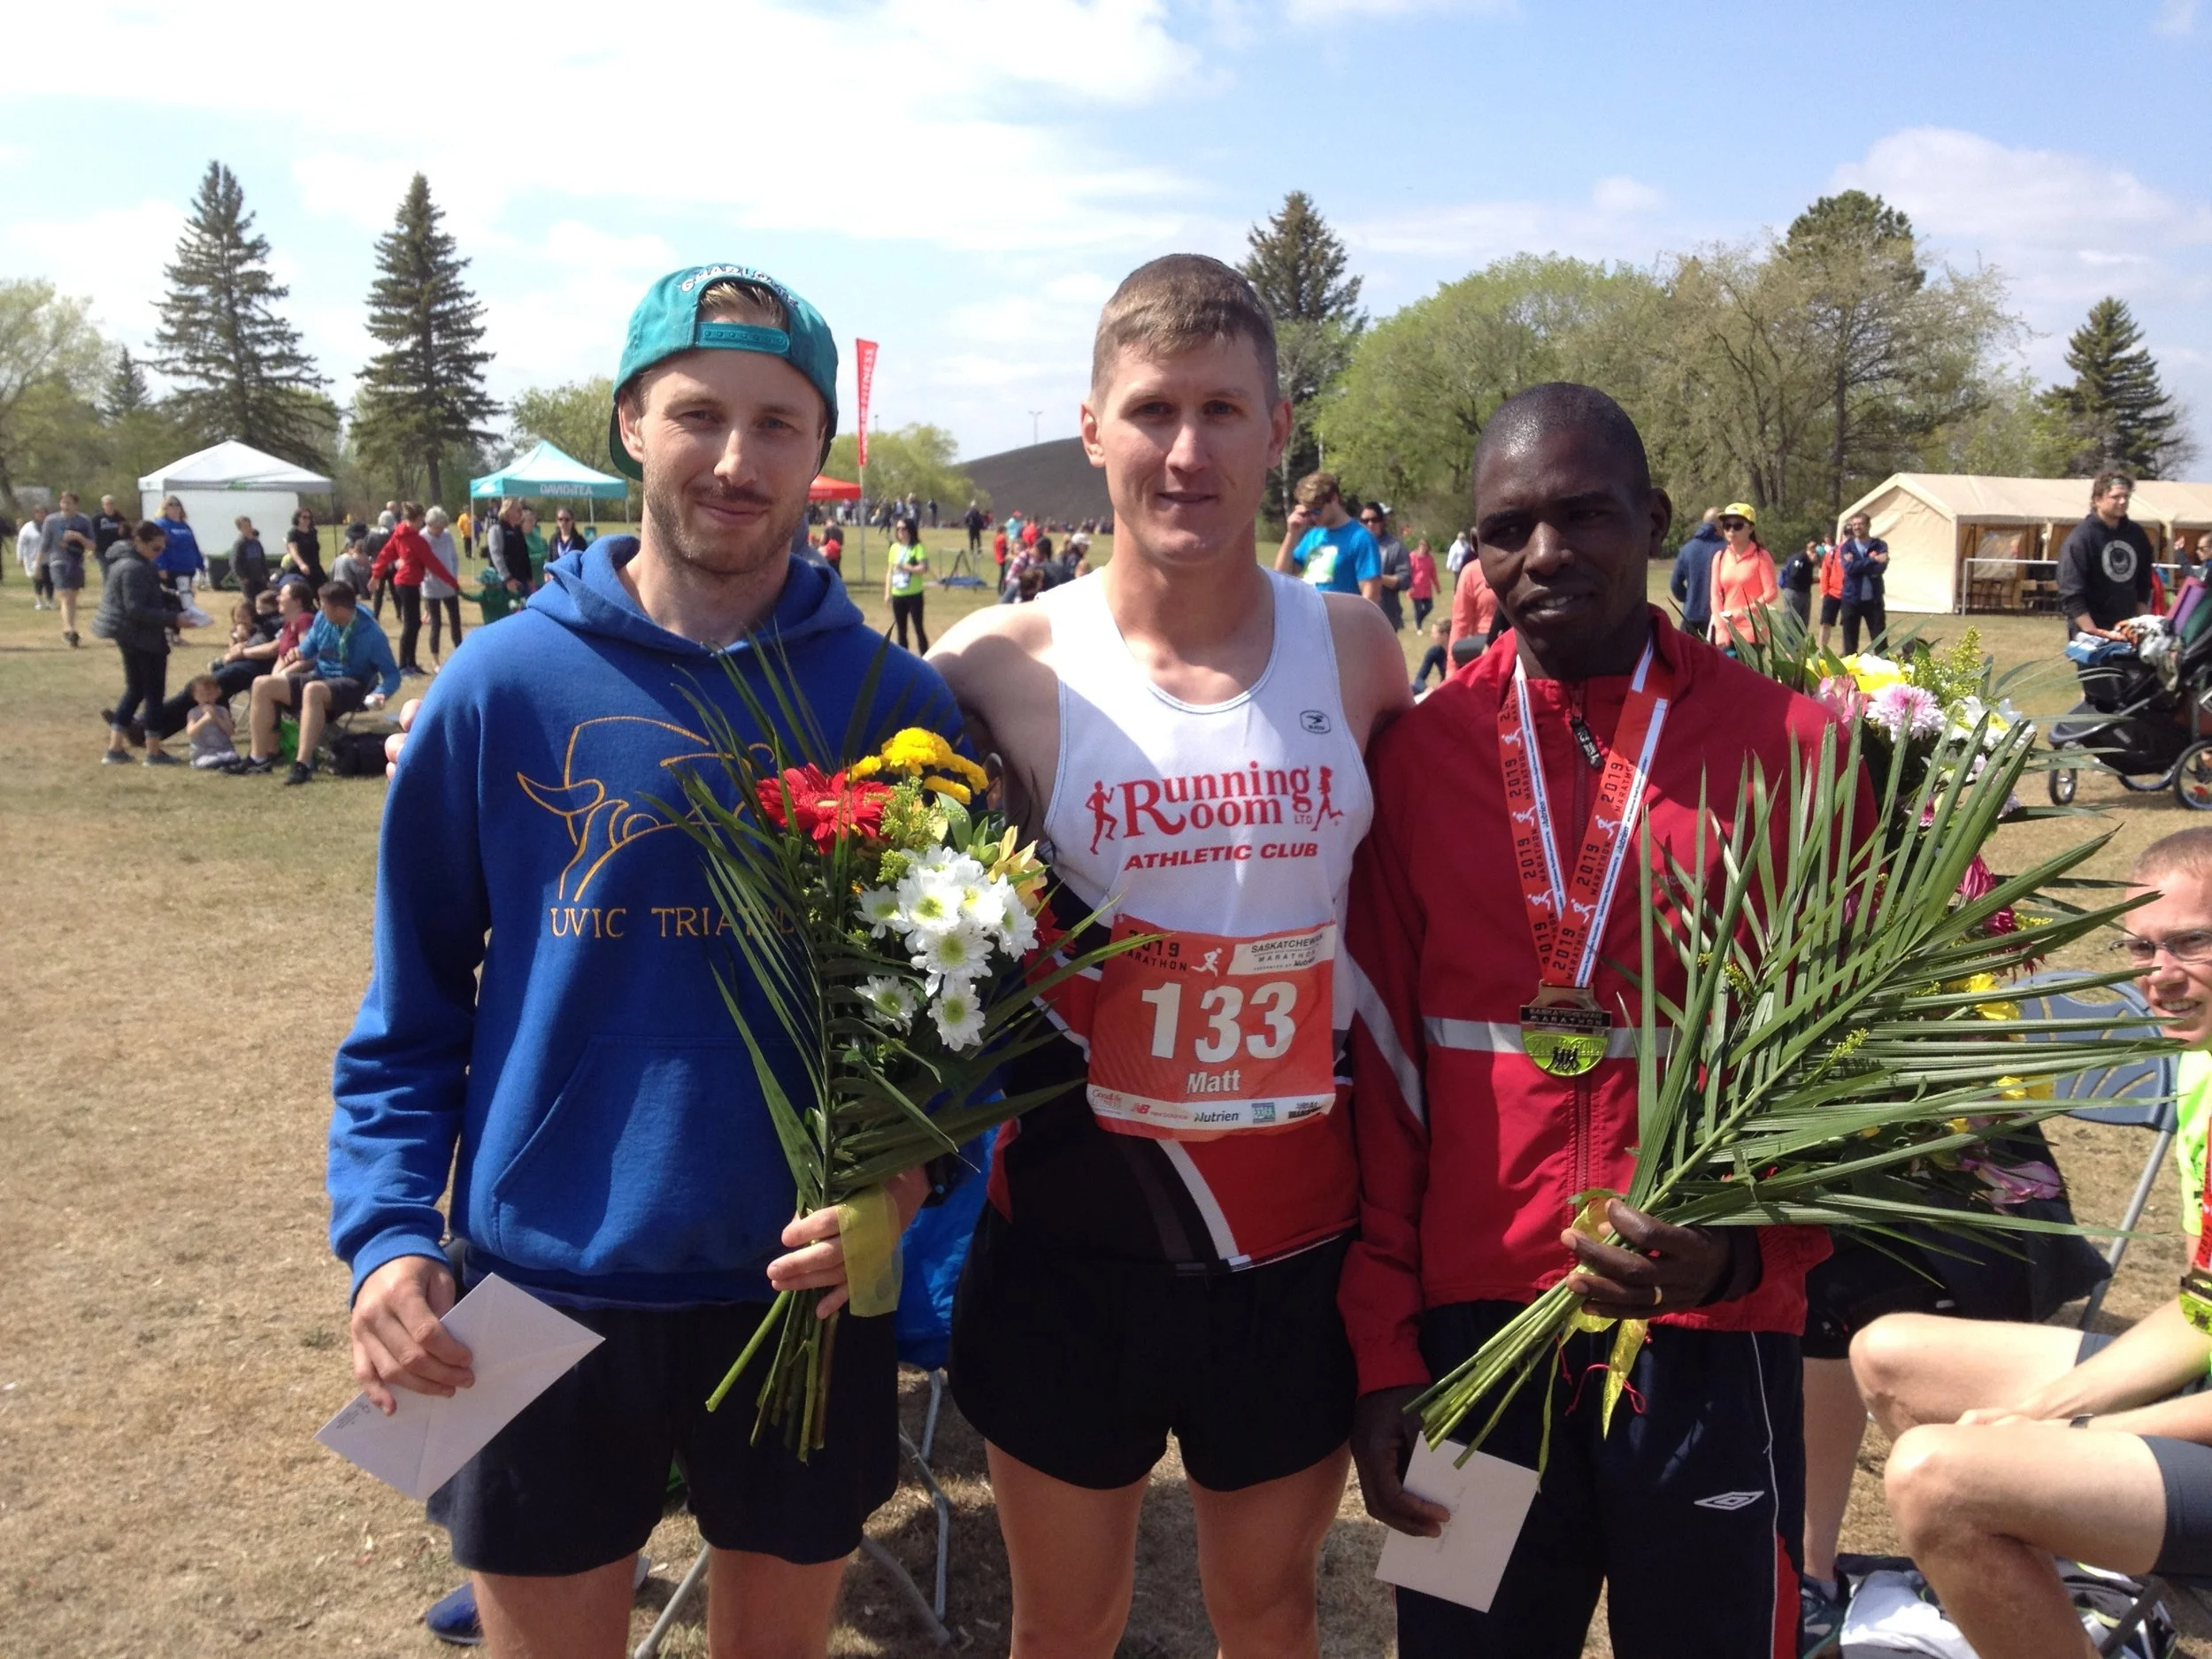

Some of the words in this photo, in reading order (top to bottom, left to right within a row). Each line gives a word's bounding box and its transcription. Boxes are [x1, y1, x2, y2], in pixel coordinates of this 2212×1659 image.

[1505, 758, 1522, 797] 2019
[1518, 749, 1532, 800] MARATHON
[1601, 762, 1624, 803] 2019
[1613, 759, 1634, 812] MARATHON
[1118, 761, 1312, 836] Running
[1123, 843, 1252, 871] ATHLETIC
[1260, 842, 1318, 858] CLUB
[1517, 837, 1537, 879] 2019
[1532, 829, 1548, 882] MARATHON
[1577, 843, 1600, 887] 2019
[1590, 841, 1611, 896] MARATHON
[550, 907, 627, 938] UVIC
[1121, 949, 1187, 972] ARATHON
[1552, 927, 1576, 971] 2019
[1566, 925, 1587, 980] MARATHON
[1141, 980, 1297, 1063] 133
[1187, 1068, 1240, 1094] Matt
[1194, 1111, 1239, 1123] Nutrien
